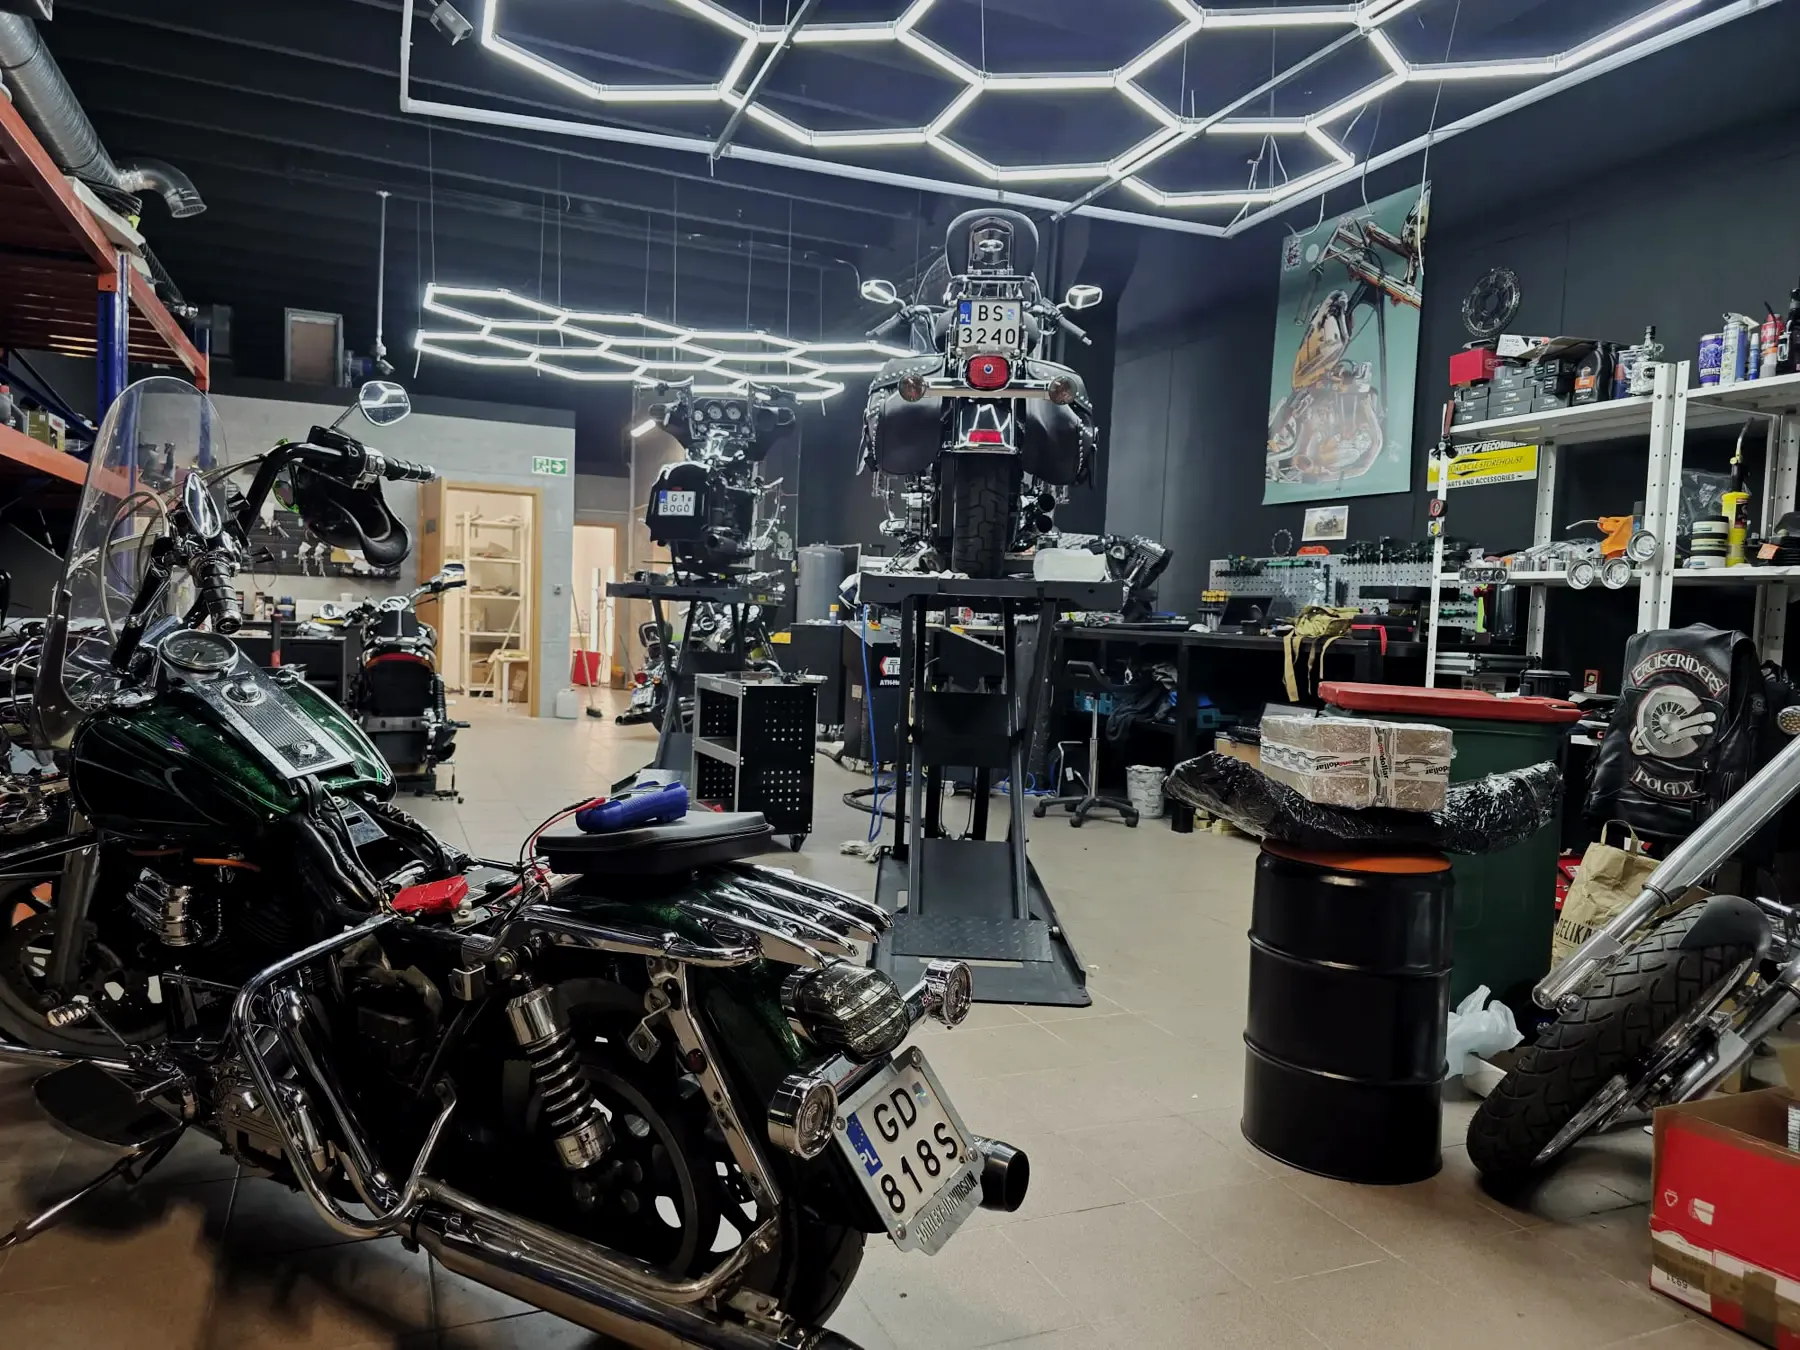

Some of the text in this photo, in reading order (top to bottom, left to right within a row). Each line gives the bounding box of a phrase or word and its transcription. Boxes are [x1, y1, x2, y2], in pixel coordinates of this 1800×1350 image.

[978, 304, 1003, 321] BS
[962, 327, 1016, 345] 3240
[1447, 479, 1462, 487] ARTS
[1475, 474, 1515, 484] ACCESSORIES
[873, 1087, 917, 1143] GD
[859, 1148, 879, 1167] PL
[880, 1122, 959, 1214] 818S
